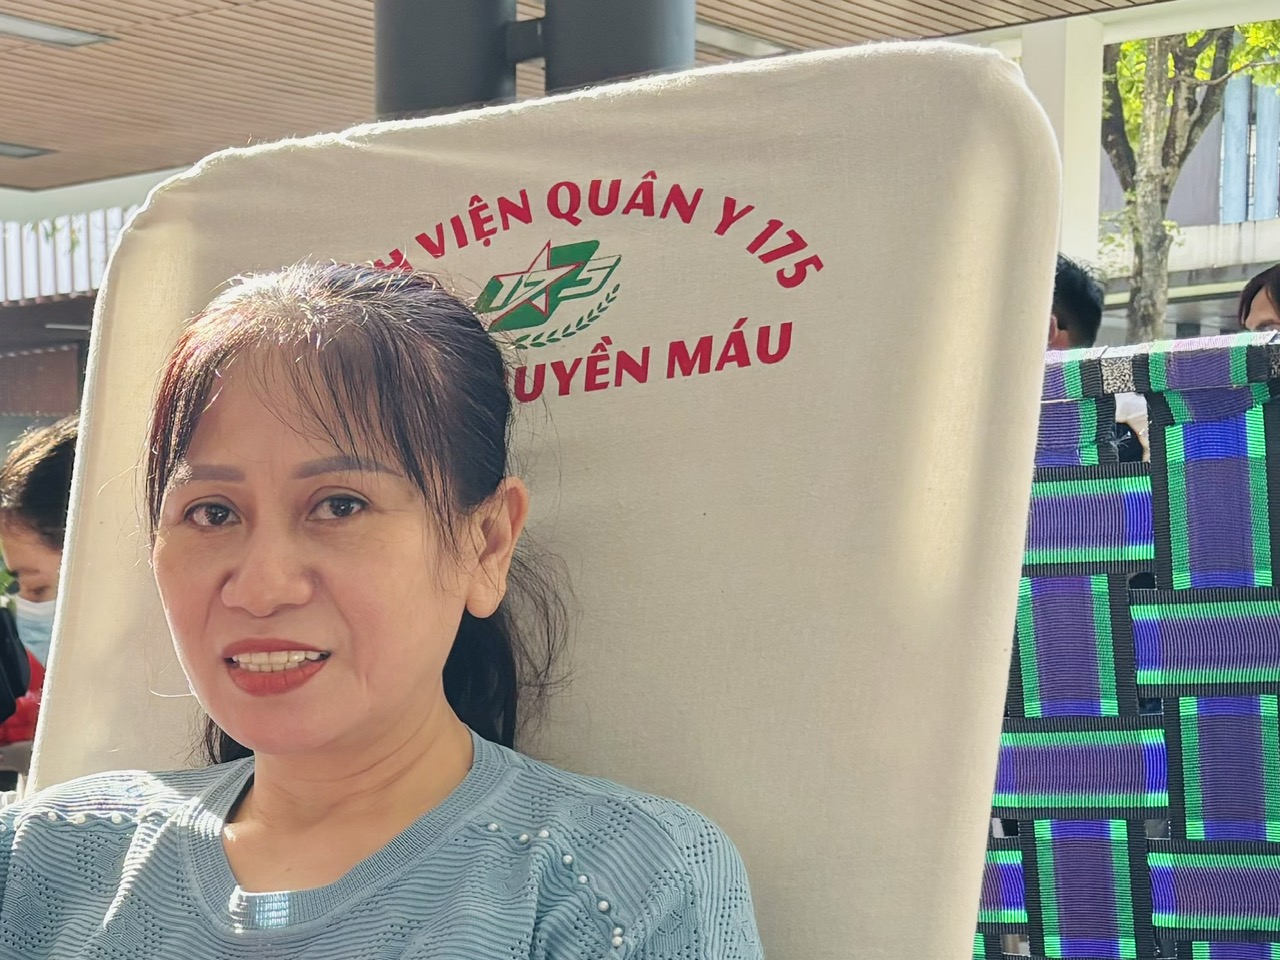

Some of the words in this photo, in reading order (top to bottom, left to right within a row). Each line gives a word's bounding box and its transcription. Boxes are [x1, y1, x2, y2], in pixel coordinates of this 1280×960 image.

[415, 188, 534, 260] VIỆN
[546, 169, 704, 227] QUÂN
[714, 196, 754, 237] Y
[747, 218, 824, 289] 175
[515, 335, 651, 403] UYỀN
[666, 317, 794, 380] MÁU
